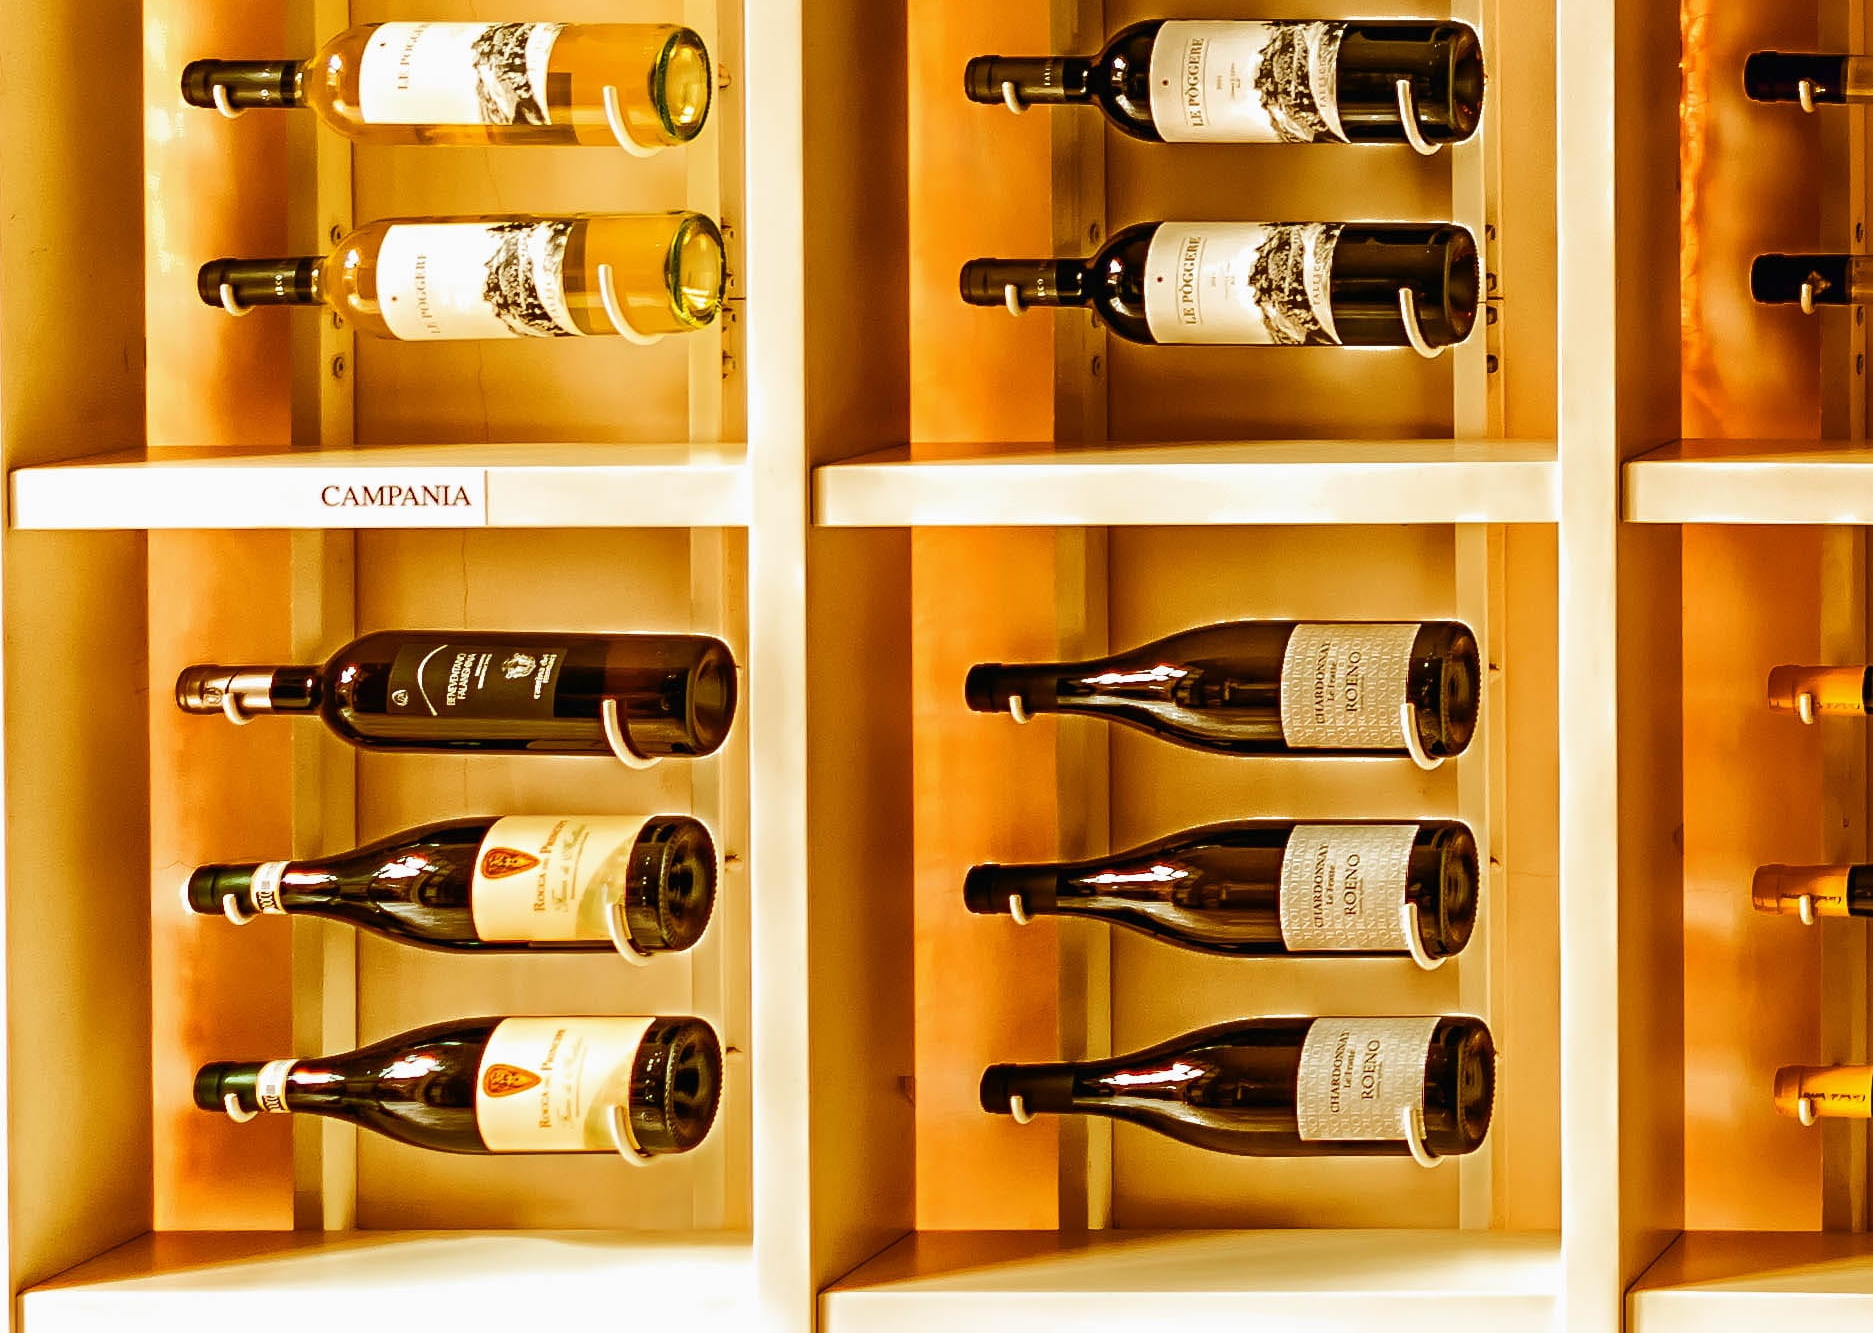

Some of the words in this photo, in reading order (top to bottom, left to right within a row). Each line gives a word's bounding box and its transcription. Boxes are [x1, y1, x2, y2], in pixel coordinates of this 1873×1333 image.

[1184, 38, 1204, 106] PÒGGERE
[1192, 110, 1204, 127] LE
[1184, 308, 1197, 325] LE
[321, 485, 472, 507] CAMPANIA
[1315, 642, 1331, 724] CHARDONNAY
[1345, 652, 1361, 713] ROENO
[1313, 844, 1328, 929] CHARDONNAY
[1343, 854, 1360, 916] ROENO
[1330, 1030, 1350, 1114] CHARDONNAY
[1360, 1040, 1381, 1100] ROENO
